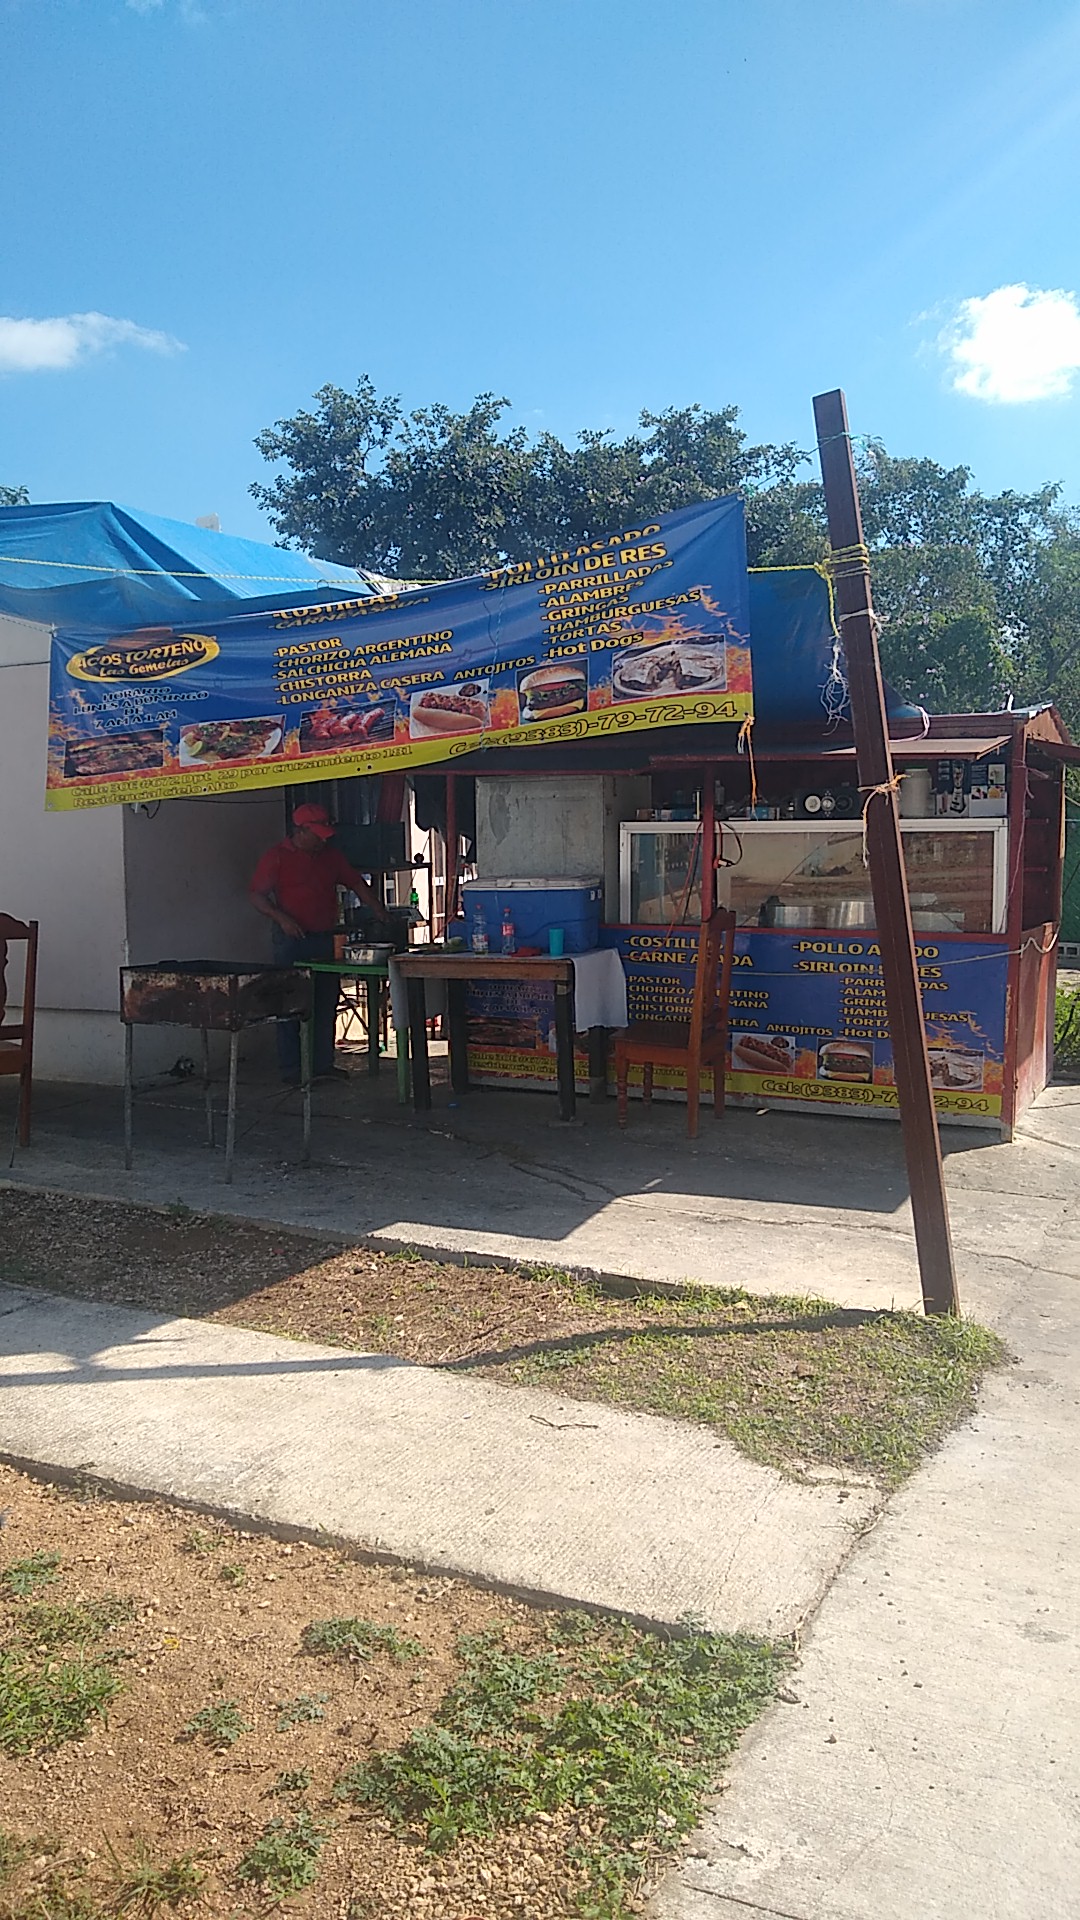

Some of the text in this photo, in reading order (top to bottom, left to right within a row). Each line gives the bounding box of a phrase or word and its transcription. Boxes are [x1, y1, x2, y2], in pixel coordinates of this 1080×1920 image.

[584, 551, 616, 571] DE
[620, 542, 667, 564] RES
[538, 560, 674, 595] -PARRILLADAS
[541, 594, 629, 621] -GRINGAS
[543, 591, 701, 634] -HAMBURGUESAS
[542, 622, 622, 646] -TORTAS
[542, 632, 644, 659] -Hot Dogs
[273, 637, 342, 658] -PASTOR
[273, 630, 453, 669] -CHORIZO ARGENTINO
[74, 652, 122, 670] ACOS
[100, 658, 189, 677] Las Gemelas
[272, 643, 452, 680] -SALCHICHA ALEMANA
[274, 669, 372, 693] -CHISTORRA
[276, 656, 535, 705] -LONGANIZA CASERA ANTOJITOS
[73, 691, 208, 715] LUNES A DOMINGO
[103, 687, 171, 702] HORARIO
[124, 707, 143, 716] DE
[72, 785, 108, 796] Calle
[240, 766, 271, 778] por
[272, 752, 380, 773] cruzamiento
[793, 941, 939, 958] -POLLO ADO
[793, 960, 874, 974] -SIRLOIN
[840, 977, 949, 990] -PARRDAS
[628, 1003, 693, 1013] CHISTORR
[767, 1023, 832, 1036] ANTOJITOS
[839, 1027, 873, 1037] -Hot
